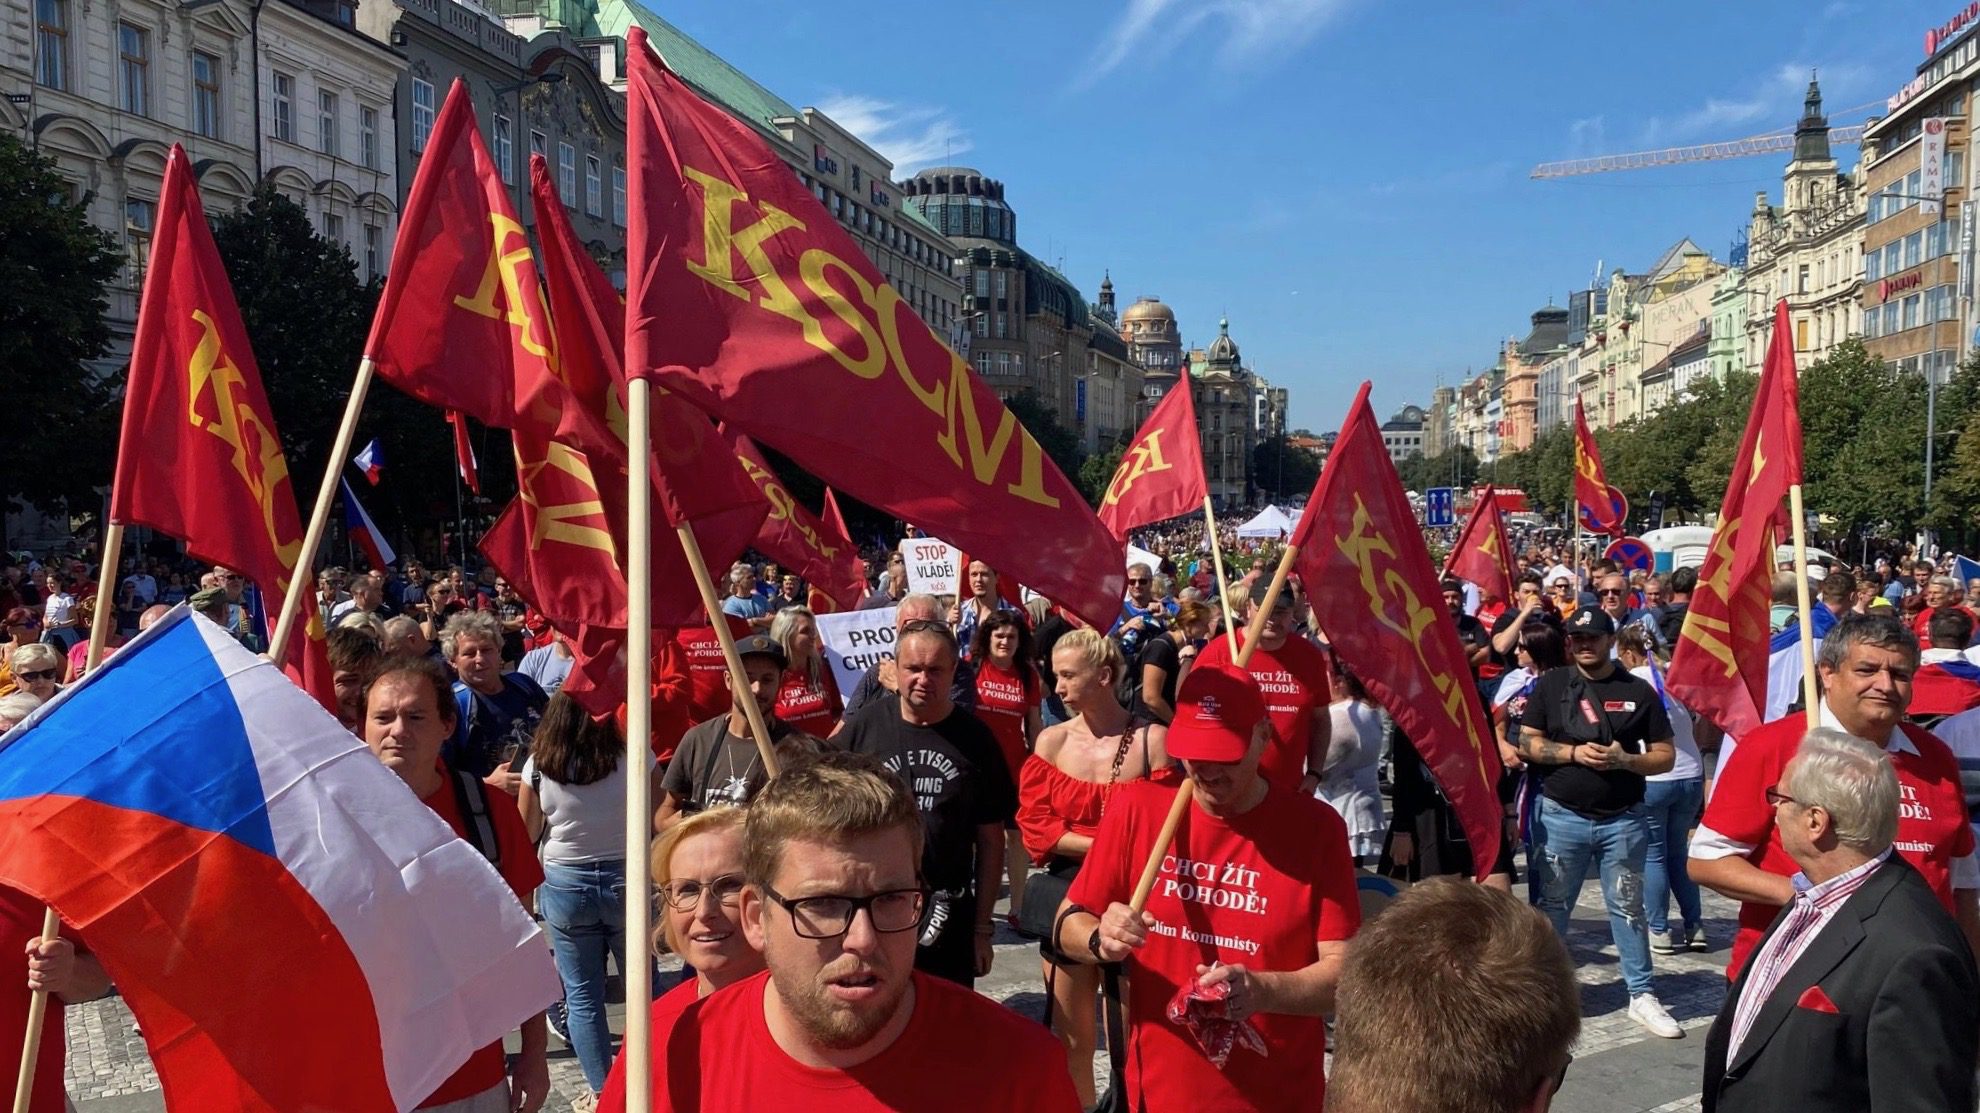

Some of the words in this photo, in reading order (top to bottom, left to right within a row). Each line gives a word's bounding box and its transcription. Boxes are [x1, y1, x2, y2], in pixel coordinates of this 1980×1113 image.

[915, 545, 947, 561] STOP
[917, 561, 955, 578] VLÁDĚ!
[1250, 671, 1273, 681] HCI
[919, 749, 960, 781] TYSON
[1160, 855, 1217, 882] CHCI
[1220, 862, 1260, 889] ŽÍT
[1162, 879, 1268, 915] POHODĚ!
[1181, 925, 1260, 956] komunisty
